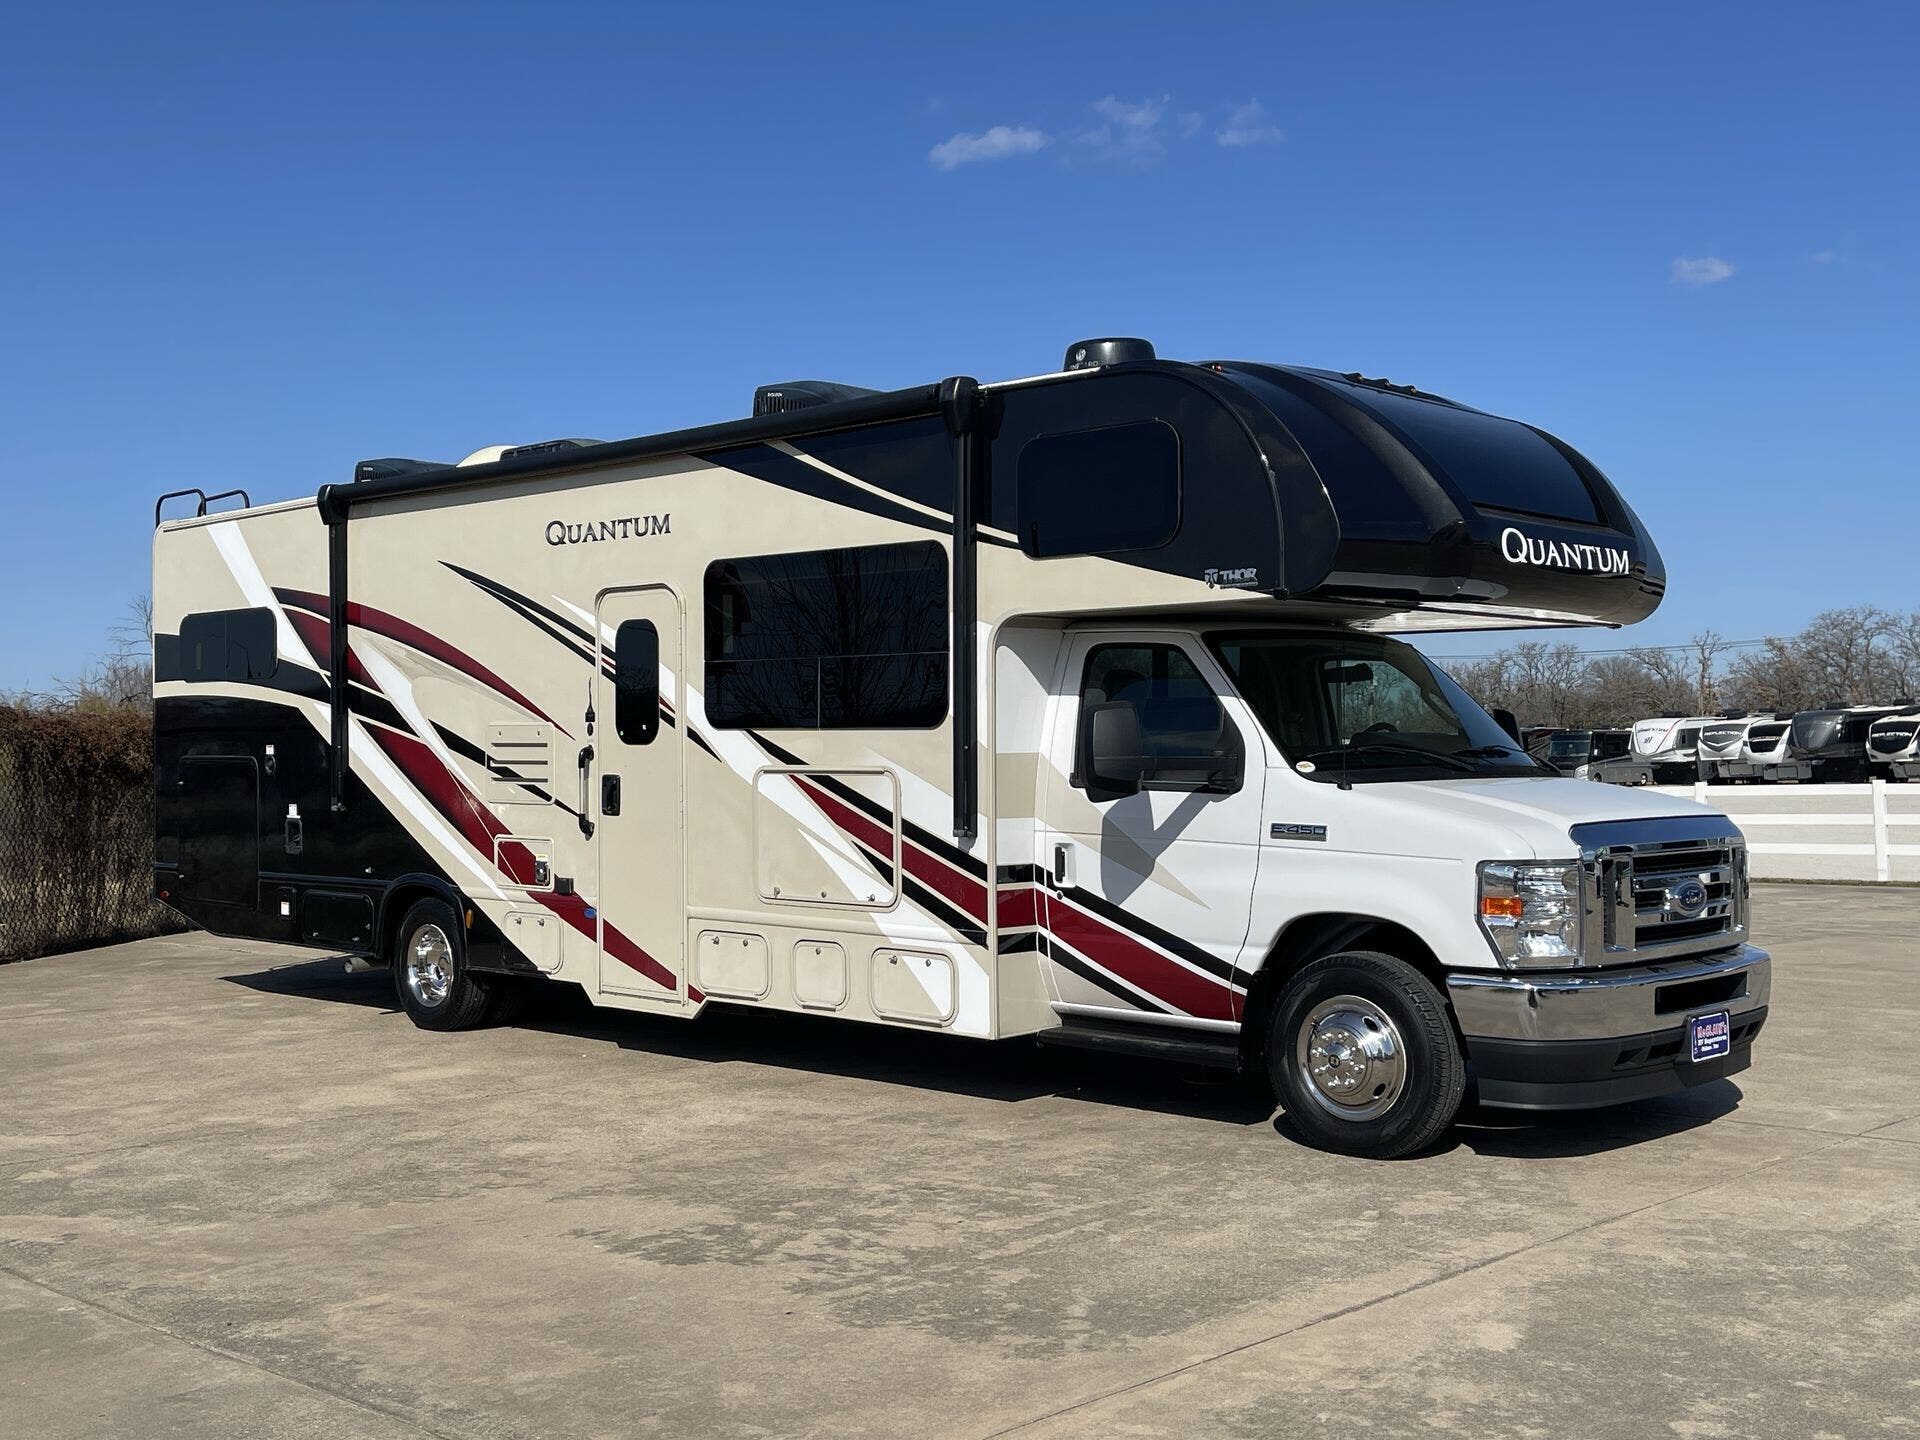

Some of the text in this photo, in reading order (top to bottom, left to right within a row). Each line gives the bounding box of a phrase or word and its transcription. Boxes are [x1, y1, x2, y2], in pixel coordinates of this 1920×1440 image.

[545, 513, 671, 546] QUANTUM
[1501, 527, 1630, 575] QUANTUM
[1219, 567, 1258, 582] THOR
